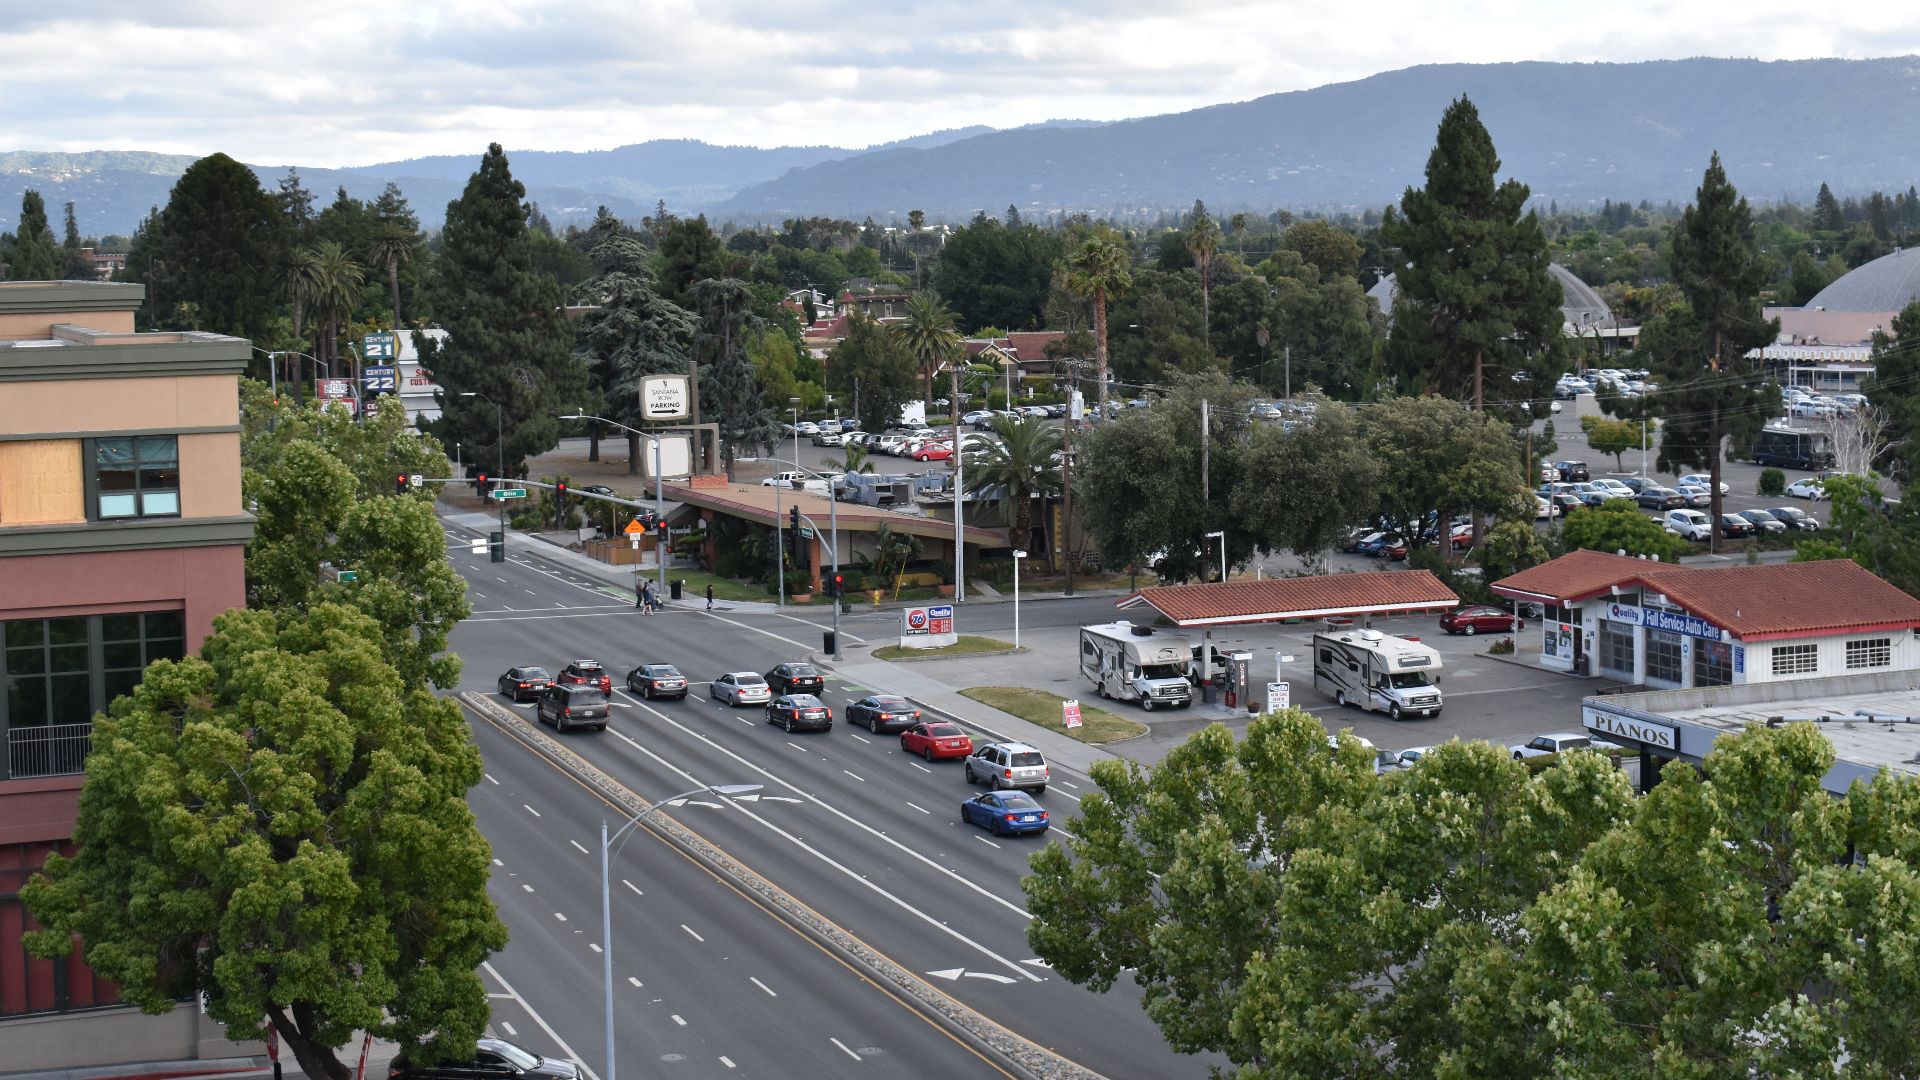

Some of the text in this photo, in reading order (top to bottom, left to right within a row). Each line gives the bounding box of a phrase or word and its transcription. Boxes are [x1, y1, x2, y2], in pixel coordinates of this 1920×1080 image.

[366, 344, 392, 356] 21
[367, 378, 394, 388] 22
[912, 613, 924, 624] 76
[1612, 604, 1719, 638] Quality Full Service Auto Care
[1596, 716, 1669, 746] PIANOS
